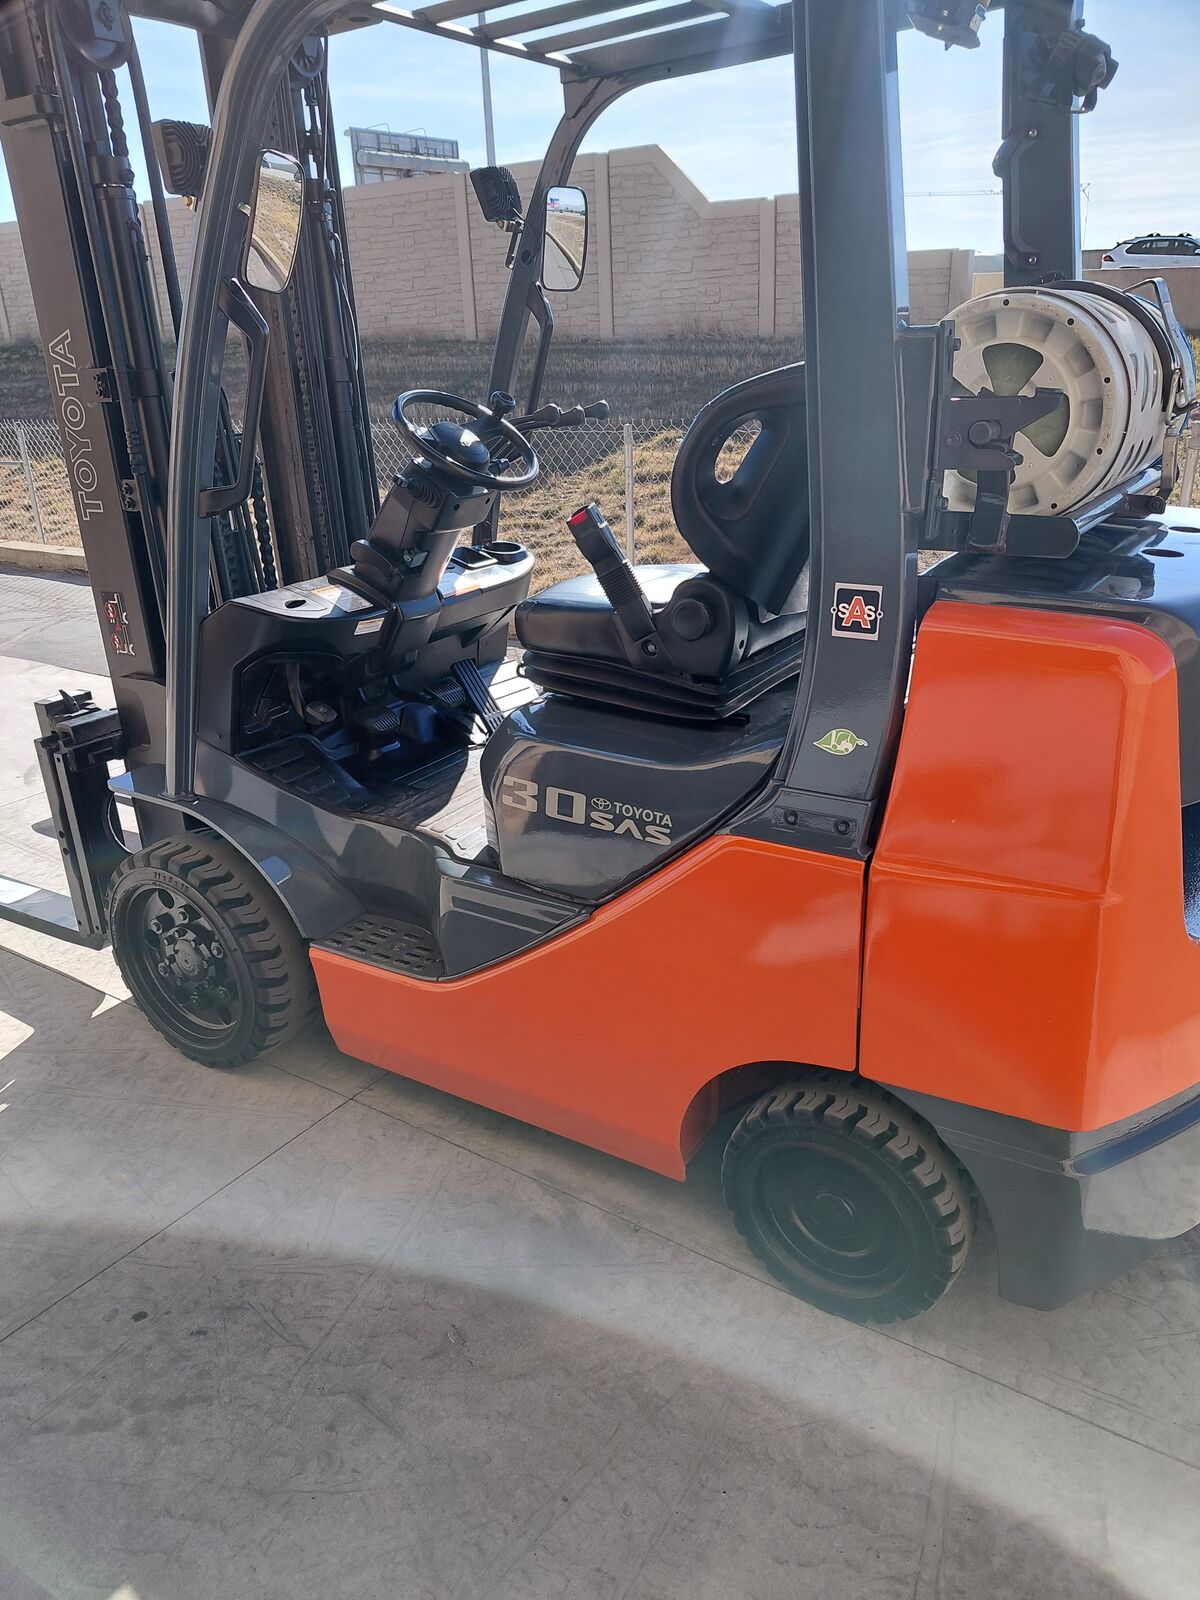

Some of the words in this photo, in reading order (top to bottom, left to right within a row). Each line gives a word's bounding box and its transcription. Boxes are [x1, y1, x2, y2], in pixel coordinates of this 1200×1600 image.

[48, 328, 104, 521] TOYOTA
[837, 595, 876, 629] SAS
[502, 775, 587, 825] 30
[613, 802, 673, 828] TOYOTA
[589, 811, 672, 846] SAS
